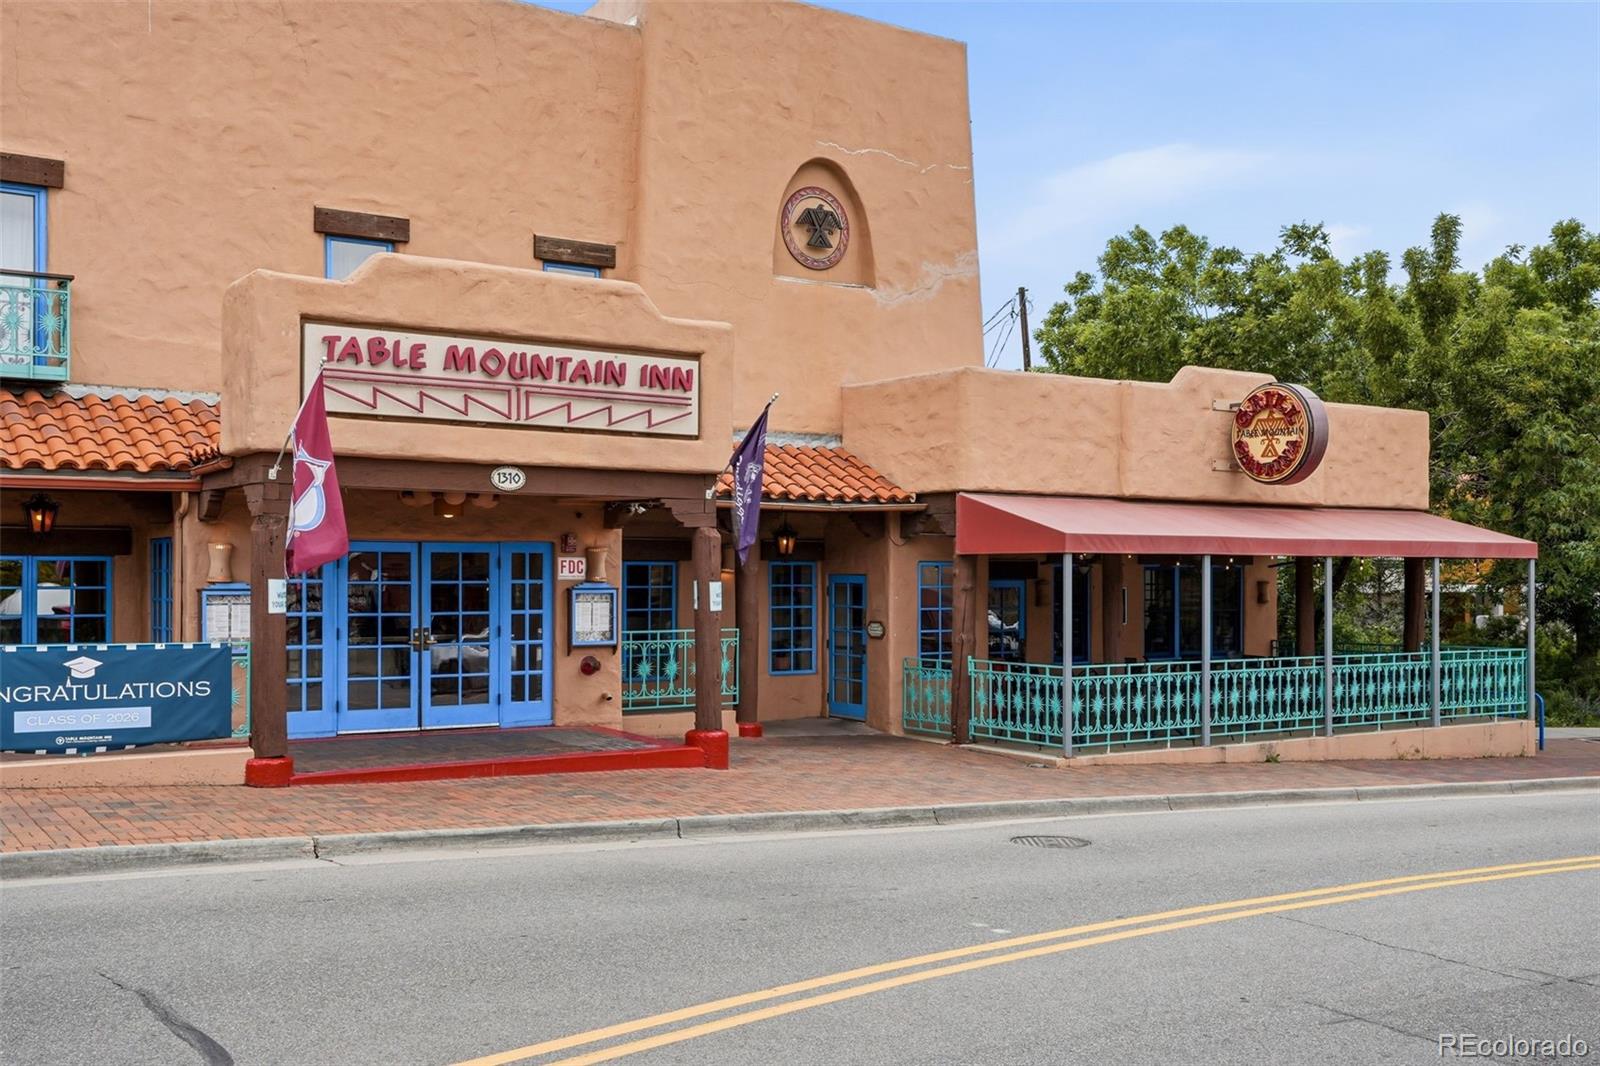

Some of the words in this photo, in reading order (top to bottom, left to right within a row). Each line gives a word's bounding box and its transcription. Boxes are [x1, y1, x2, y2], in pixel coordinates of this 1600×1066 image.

[321, 335, 427, 369] TABLE
[443, 344, 627, 387] MOUNTAIN
[640, 364, 694, 392] INN
[497, 472, 521, 484] 1310
[560, 559, 584, 574] FDC
[27, 714, 77, 726] CLASS
[81, 713, 101, 724] OF
[106, 711, 140, 723] 2026
